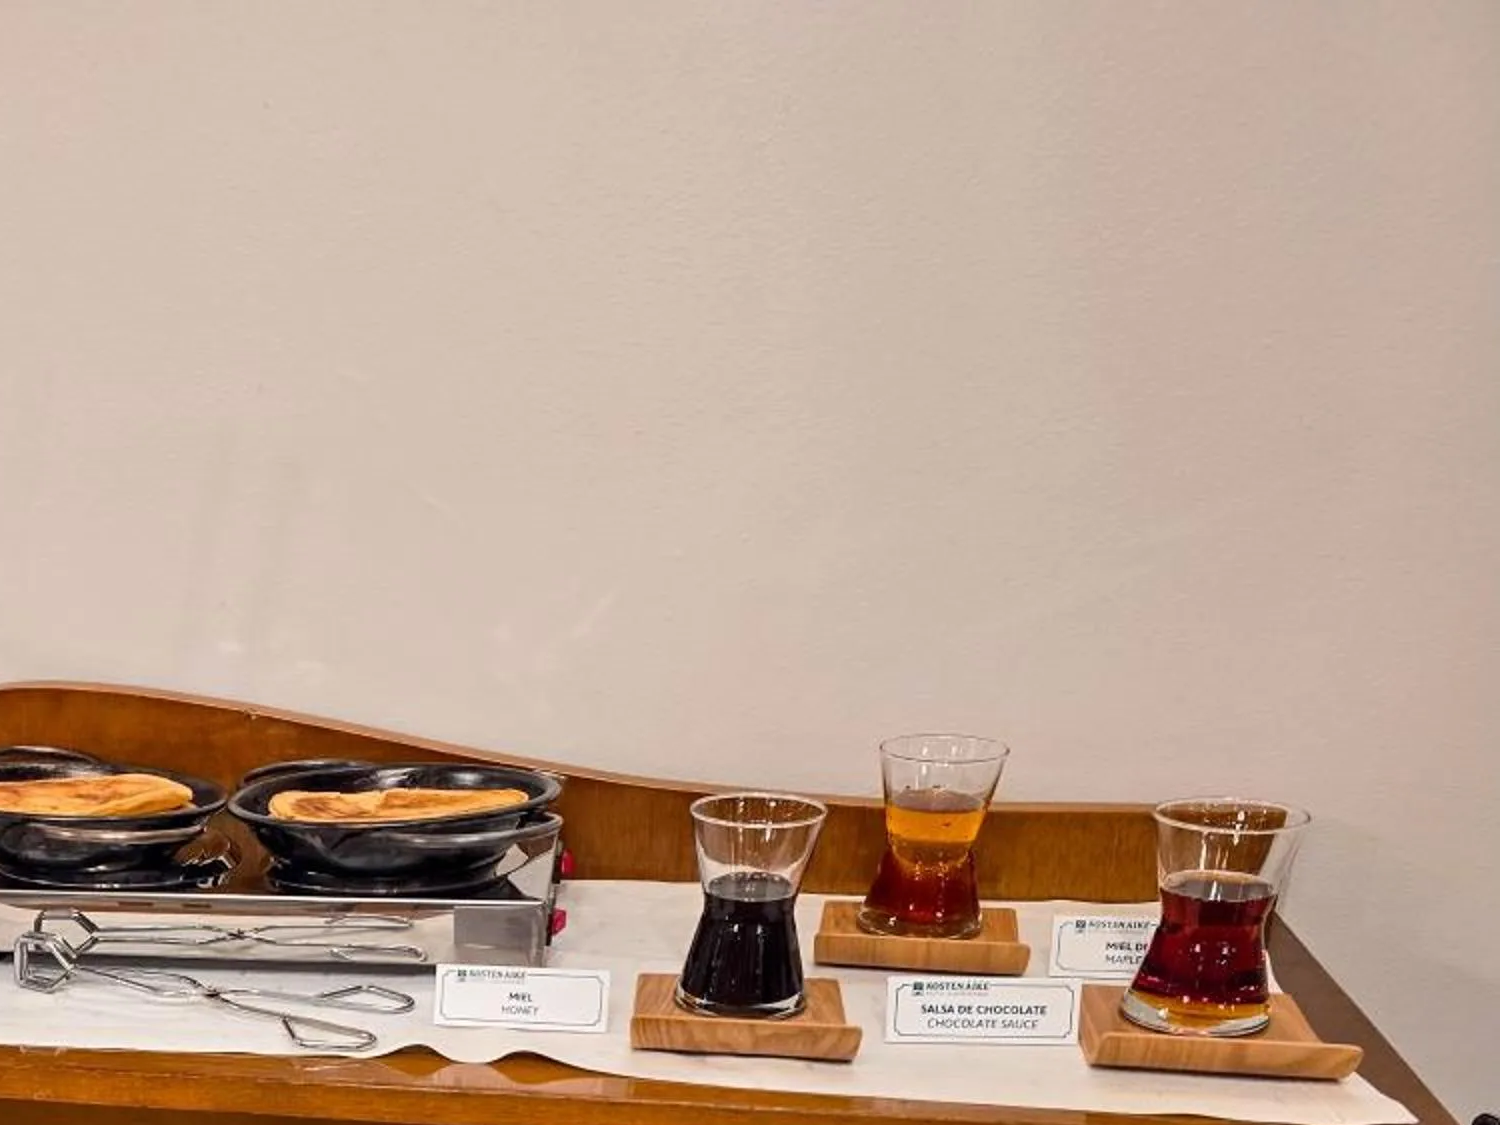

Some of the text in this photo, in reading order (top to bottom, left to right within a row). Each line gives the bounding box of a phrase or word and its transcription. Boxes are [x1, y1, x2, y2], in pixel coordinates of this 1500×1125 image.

[1105, 942, 1132, 951] MIEL
[509, 991, 533, 1002] MIEL
[501, 1004, 540, 1016] HONEY
[921, 1003, 1047, 1016] SALSA DE CHOCOLATE
[927, 1018, 1040, 1030] CHOCOLATE SAUCE
